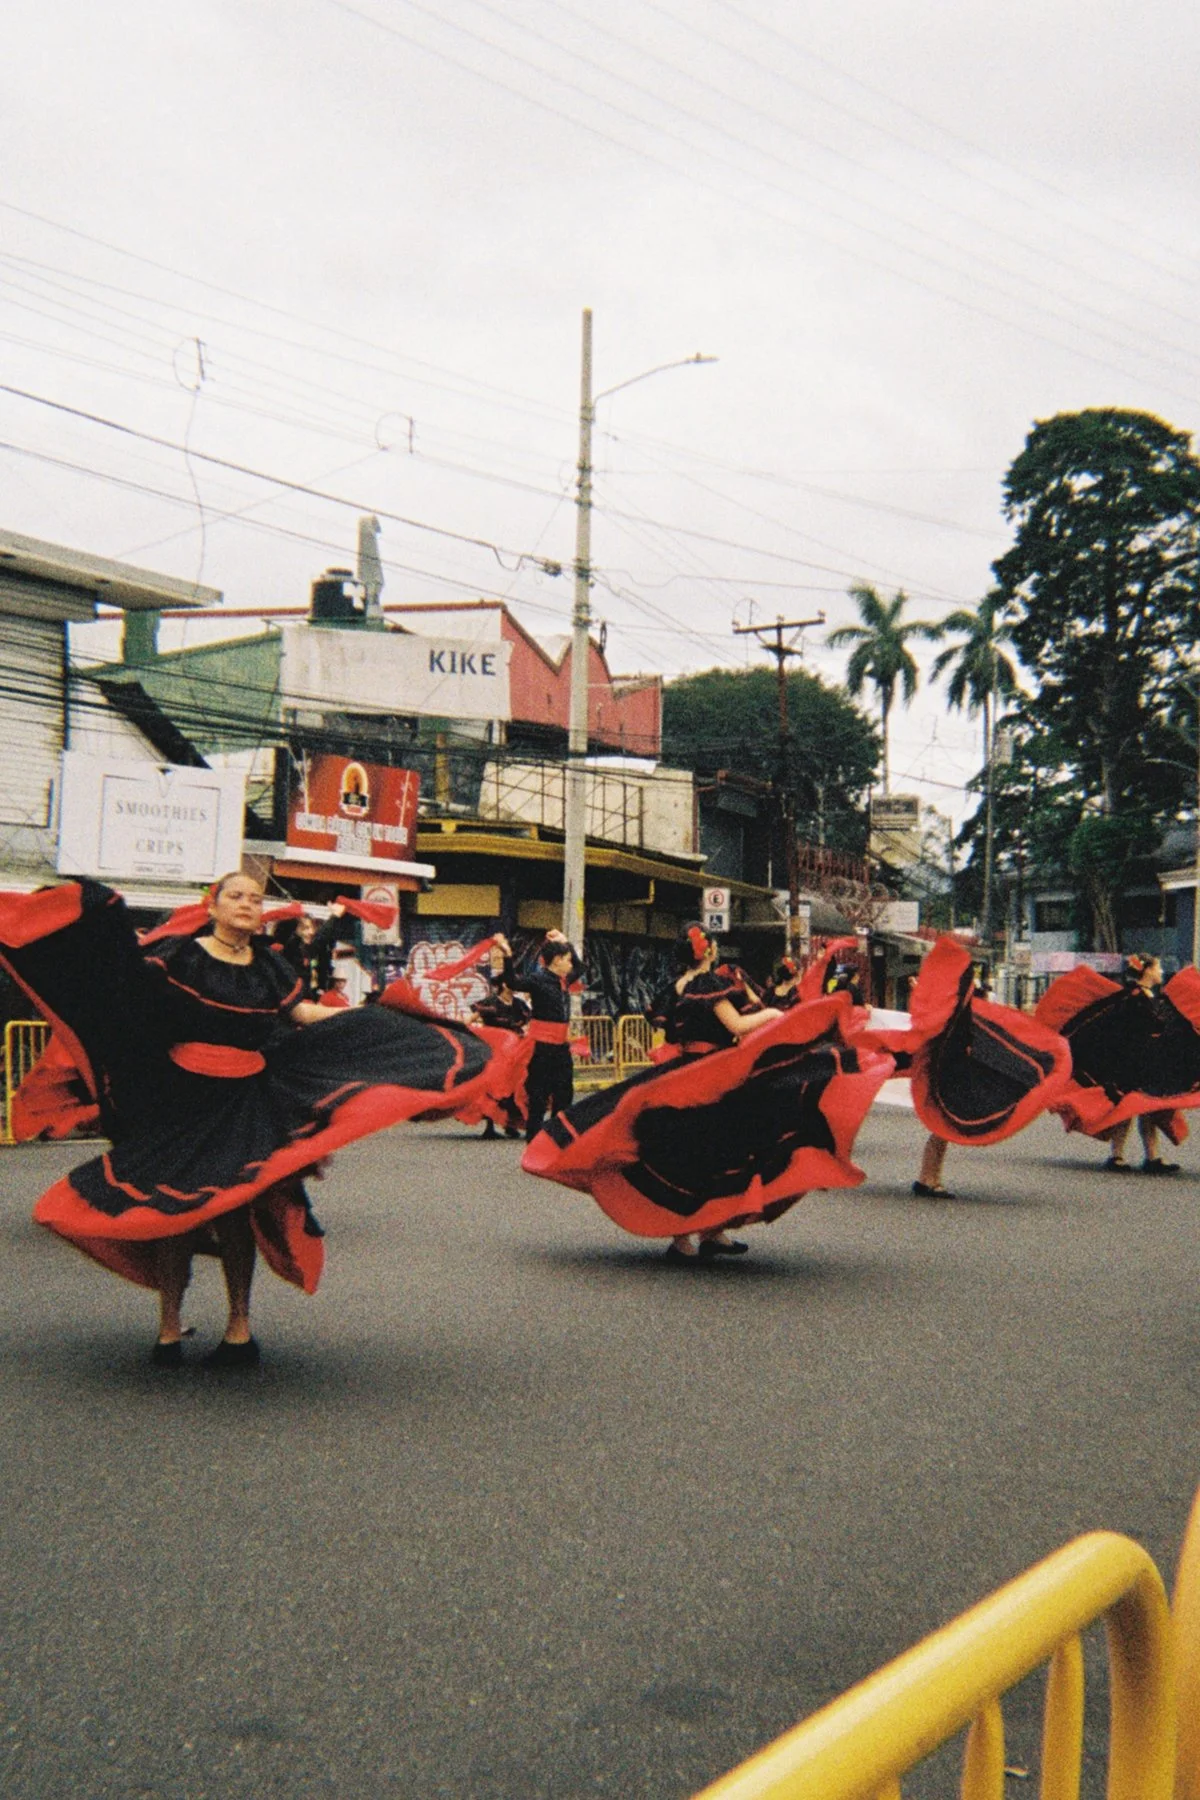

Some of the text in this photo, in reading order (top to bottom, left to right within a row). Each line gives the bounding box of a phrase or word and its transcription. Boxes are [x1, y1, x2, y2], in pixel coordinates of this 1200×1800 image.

[429, 649, 496, 676] KIKE
[115, 799, 207, 821] SMOOTHIES
[713, 894, 720, 904] E
